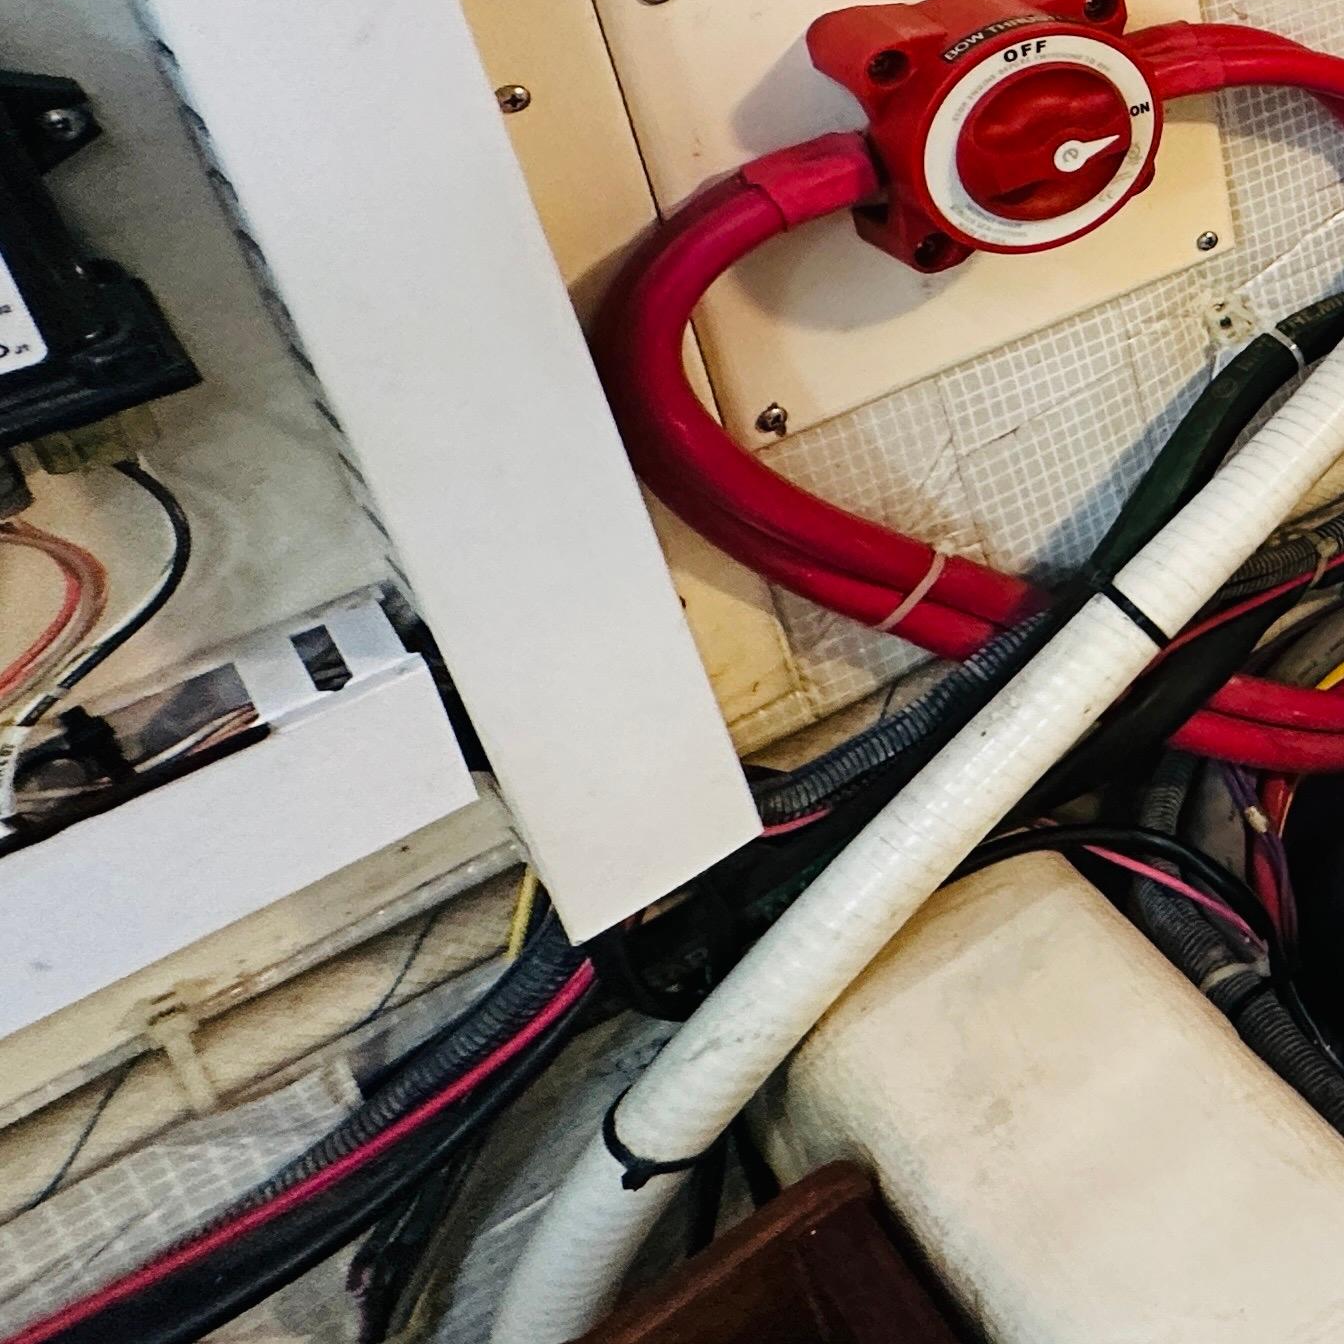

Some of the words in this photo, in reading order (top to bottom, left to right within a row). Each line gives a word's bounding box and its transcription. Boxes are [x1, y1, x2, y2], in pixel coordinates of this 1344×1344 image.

[944, 30, 985, 61] BOW
[1003, 40, 1047, 63] OFF
[1130, 101, 1150, 117] ON
